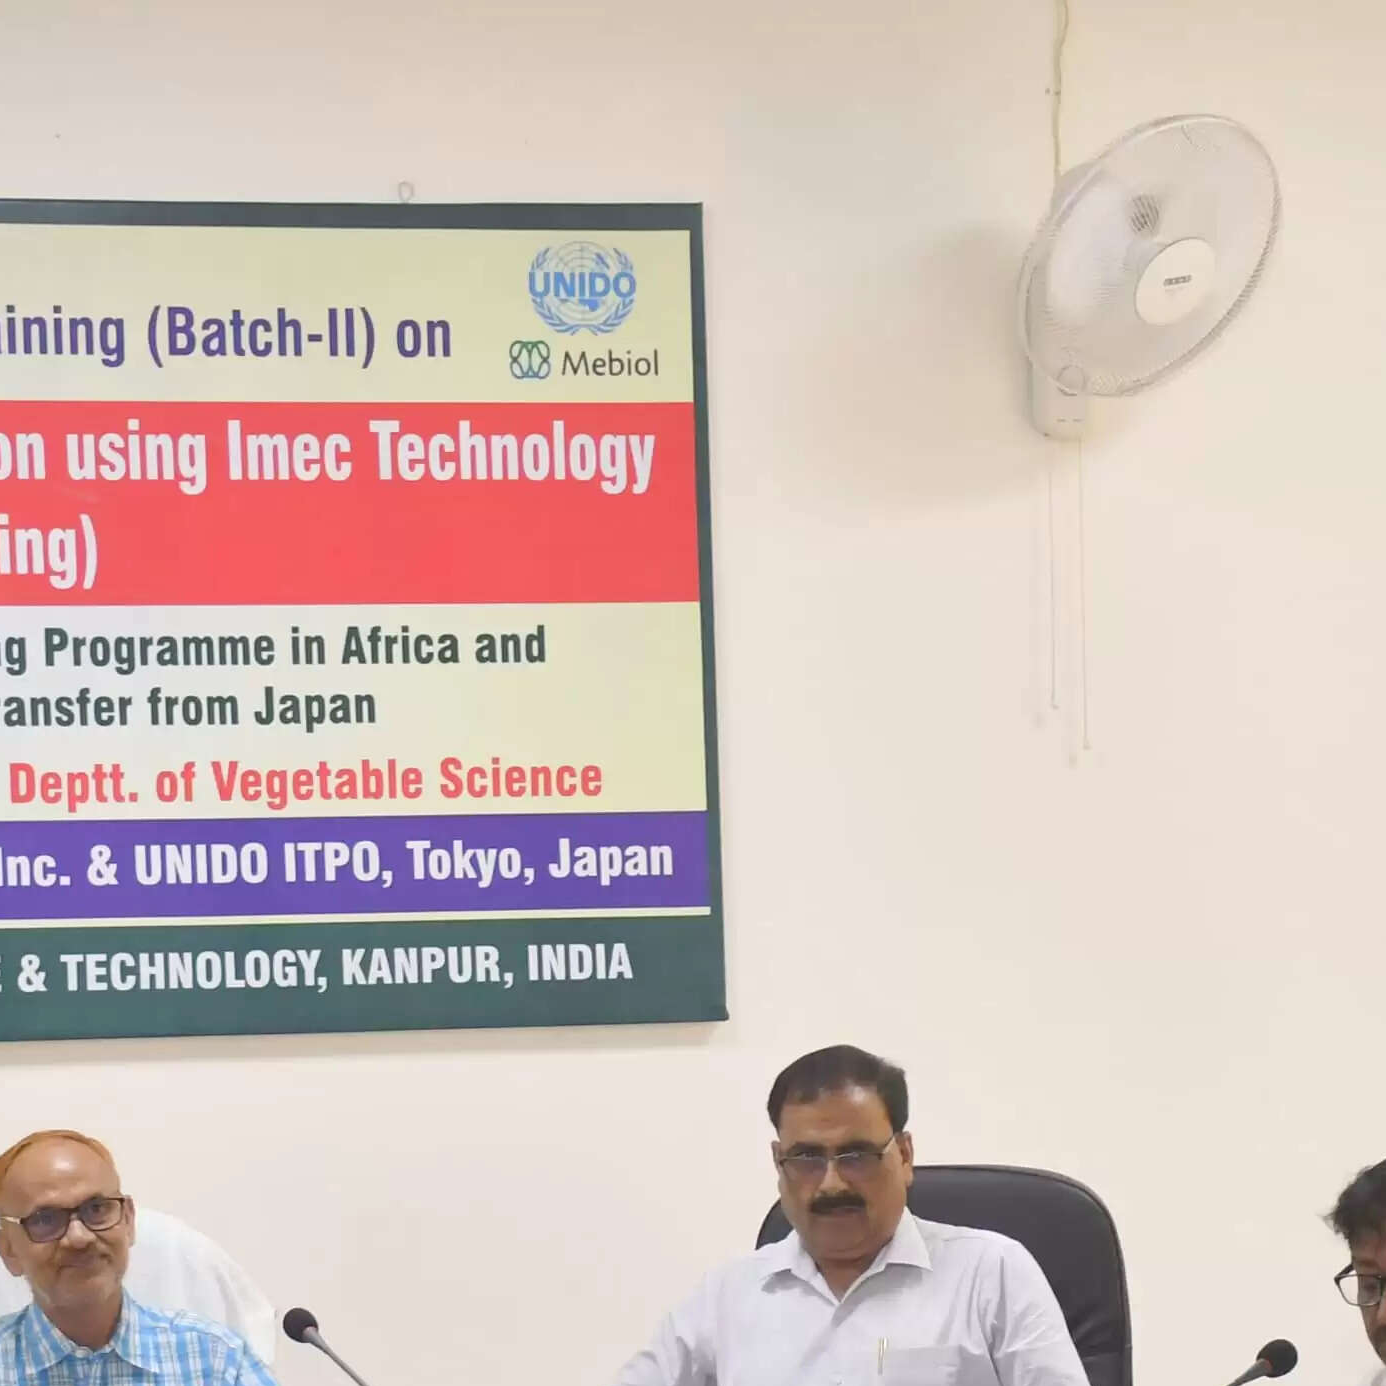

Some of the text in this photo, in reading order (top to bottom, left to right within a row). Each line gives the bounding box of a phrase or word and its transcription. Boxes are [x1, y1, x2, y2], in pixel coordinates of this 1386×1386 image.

[528, 271, 637, 299] UNIDO
[148, 305, 374, 369] (Batch-II)
[397, 320, 450, 357] on
[561, 348, 659, 377] Mebiol
[66, 420, 207, 495] using
[228, 420, 352, 481] Imec
[369, 420, 655, 494] Technology
[45, 628, 274, 675] Programme
[292, 626, 325, 664] in
[342, 626, 459, 664] Africa
[476, 625, 545, 663] and
[147, 687, 239, 725] from
[254, 686, 375, 733] Japan
[10, 763, 138, 813] Deptt.
[156, 762, 195, 802] of
[211, 759, 422, 810] Vegetable
[440, 757, 601, 798] Science
[87, 845, 118, 886] &
[135, 843, 267, 885] UNIDO
[284, 841, 392, 888] ITPO,
[406, 840, 534, 888] Tokyo,
[549, 838, 672, 886] Japan
[18, 954, 47, 992] &
[60, 949, 327, 992] TECHNOLOGY,
[342, 946, 513, 988] KANPUR,
[528, 943, 633, 980] INDIA
